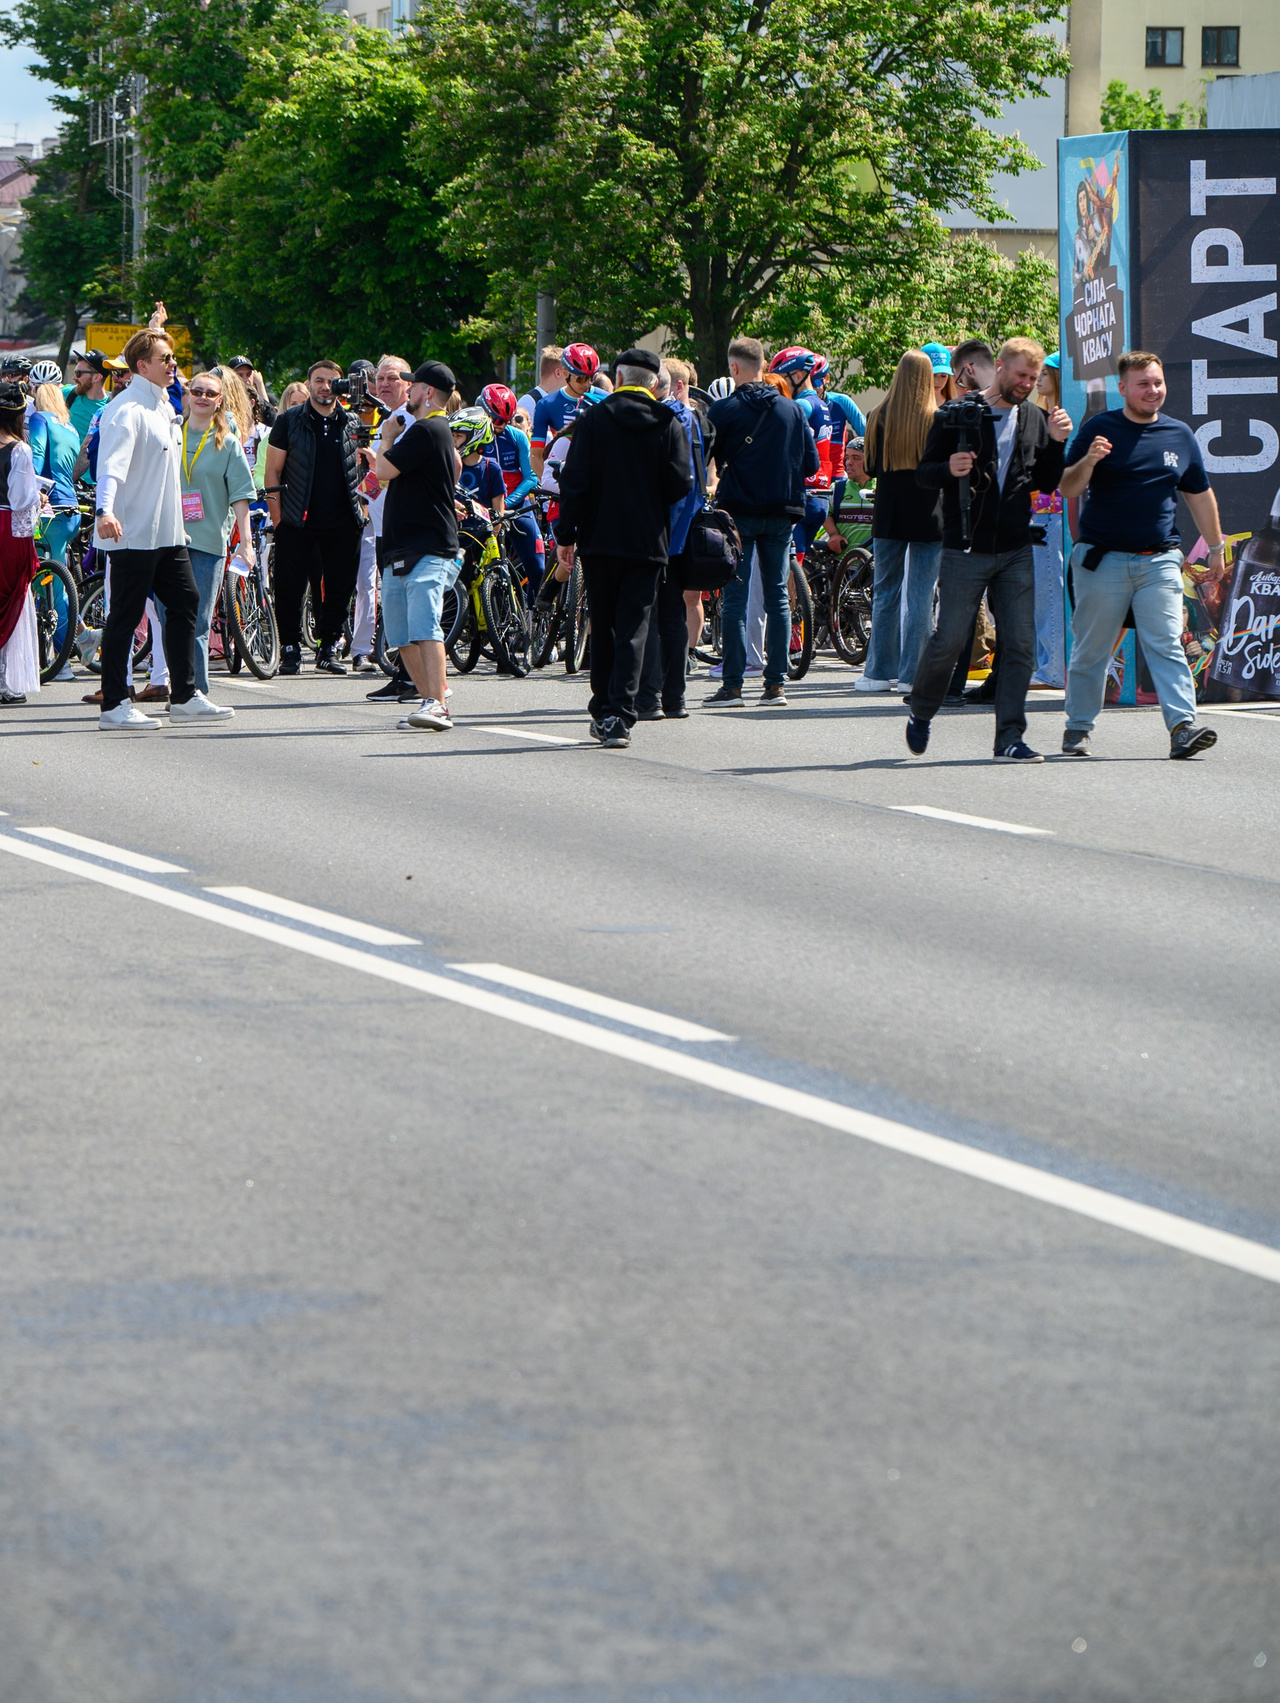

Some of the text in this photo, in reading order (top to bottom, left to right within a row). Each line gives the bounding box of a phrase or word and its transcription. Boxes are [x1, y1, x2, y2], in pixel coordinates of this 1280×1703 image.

[1084, 277, 1107, 307] СІЛА
[1074, 301, 1117, 338] ЧОРНАГА
[1189, 159, 1280, 474] СТАРТ
[1082, 330, 1113, 366] КВАСУ
